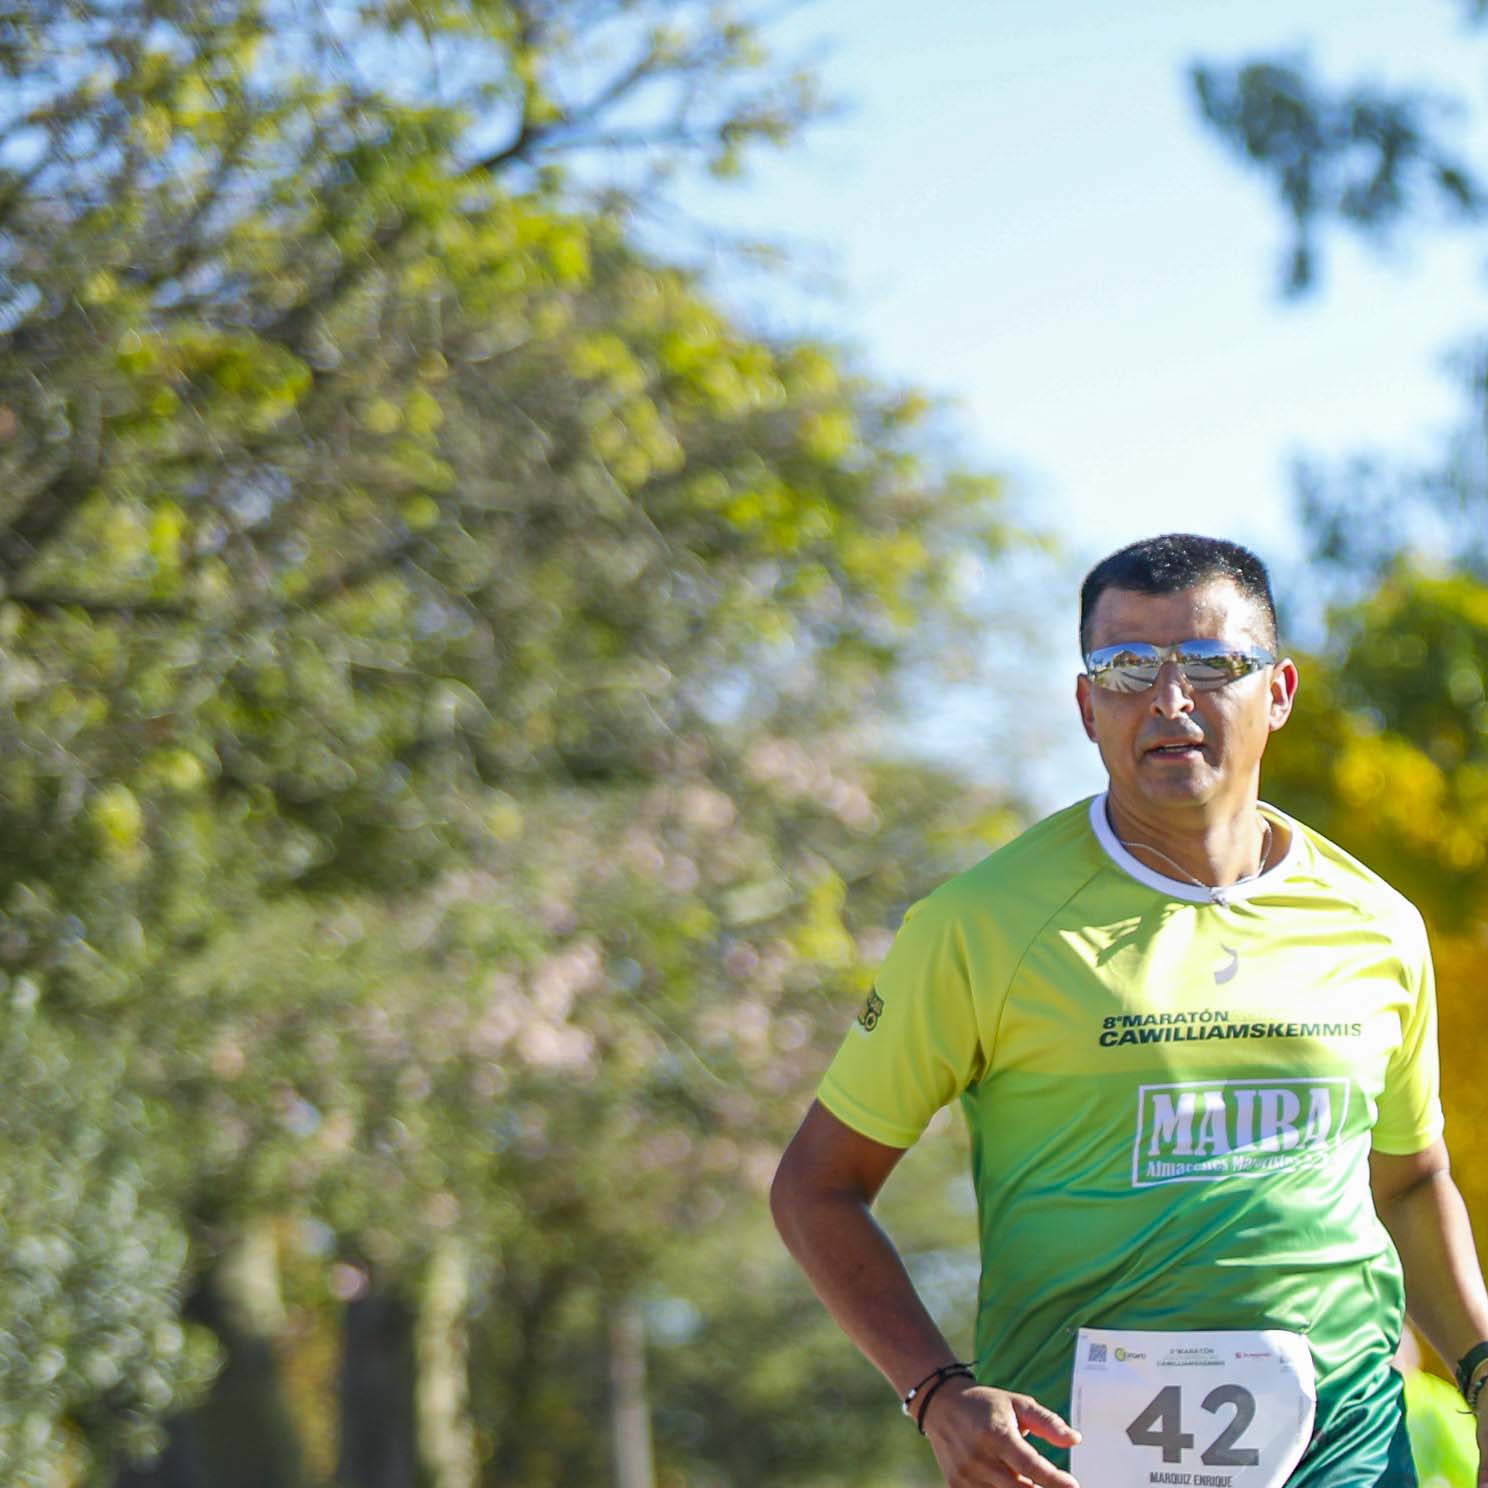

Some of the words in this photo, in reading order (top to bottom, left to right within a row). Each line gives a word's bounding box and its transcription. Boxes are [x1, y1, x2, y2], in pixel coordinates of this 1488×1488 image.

[1098, 1022, 1362, 1048] CAWILLIAMSKEMMIS
[1150, 1088, 1333, 1157] MAIRA
[1125, 1383, 1260, 1466] 42
